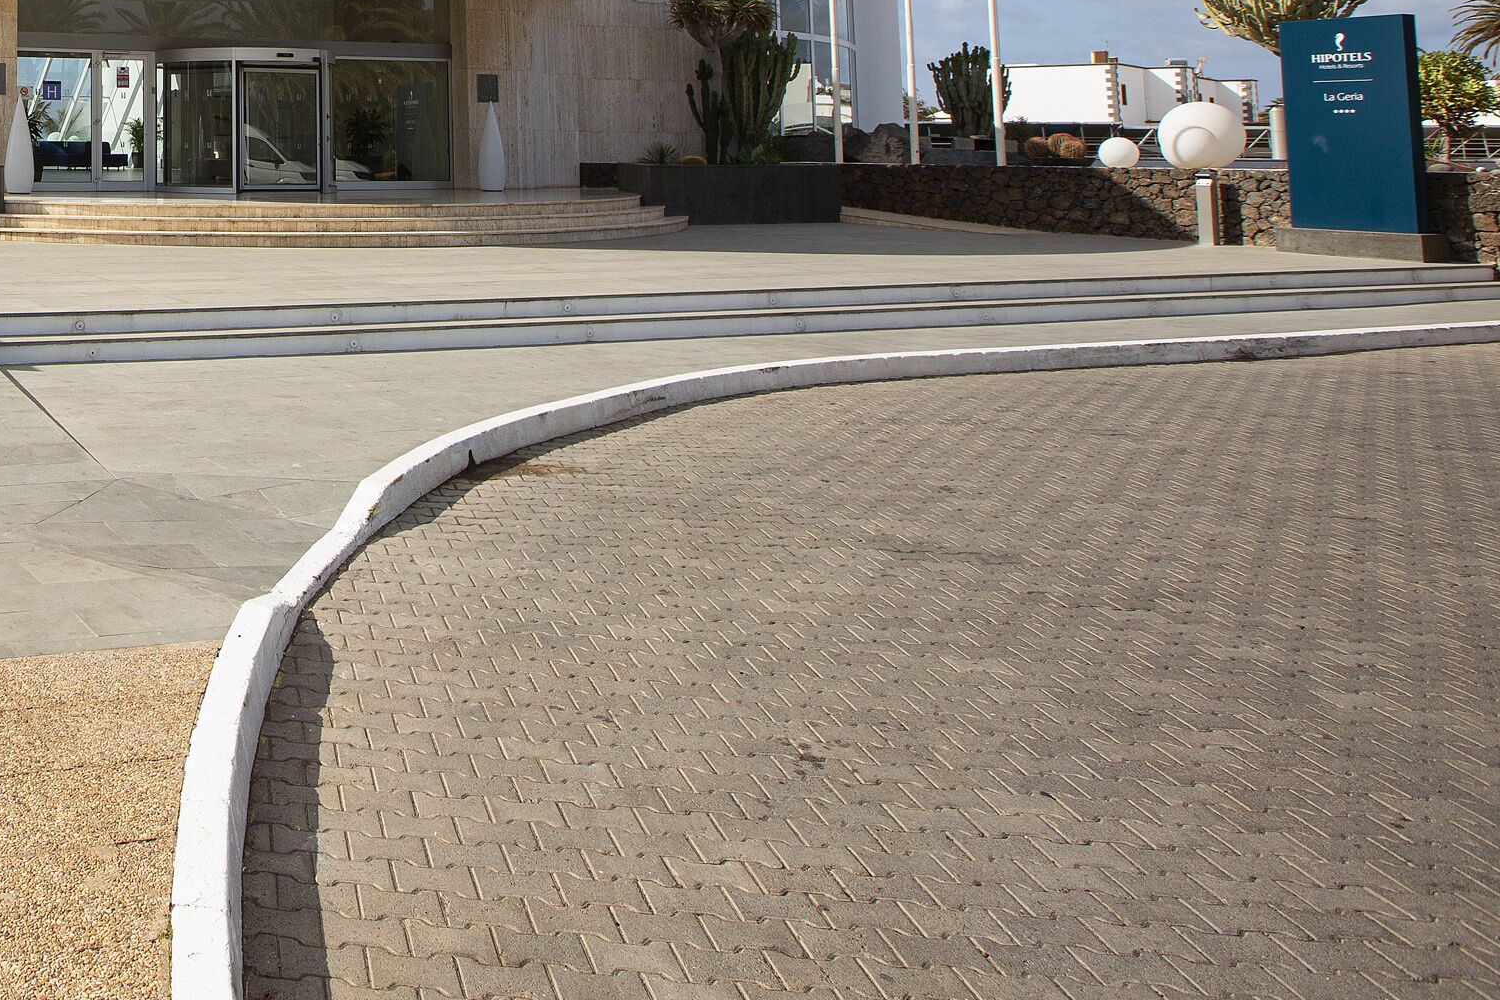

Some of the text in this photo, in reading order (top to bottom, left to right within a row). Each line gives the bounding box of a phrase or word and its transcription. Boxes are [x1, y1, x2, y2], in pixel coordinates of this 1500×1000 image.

[1311, 52, 1372, 63] HIPOTELS
[47, 86, 57, 98] H
[1324, 93, 1364, 101] La Geria
